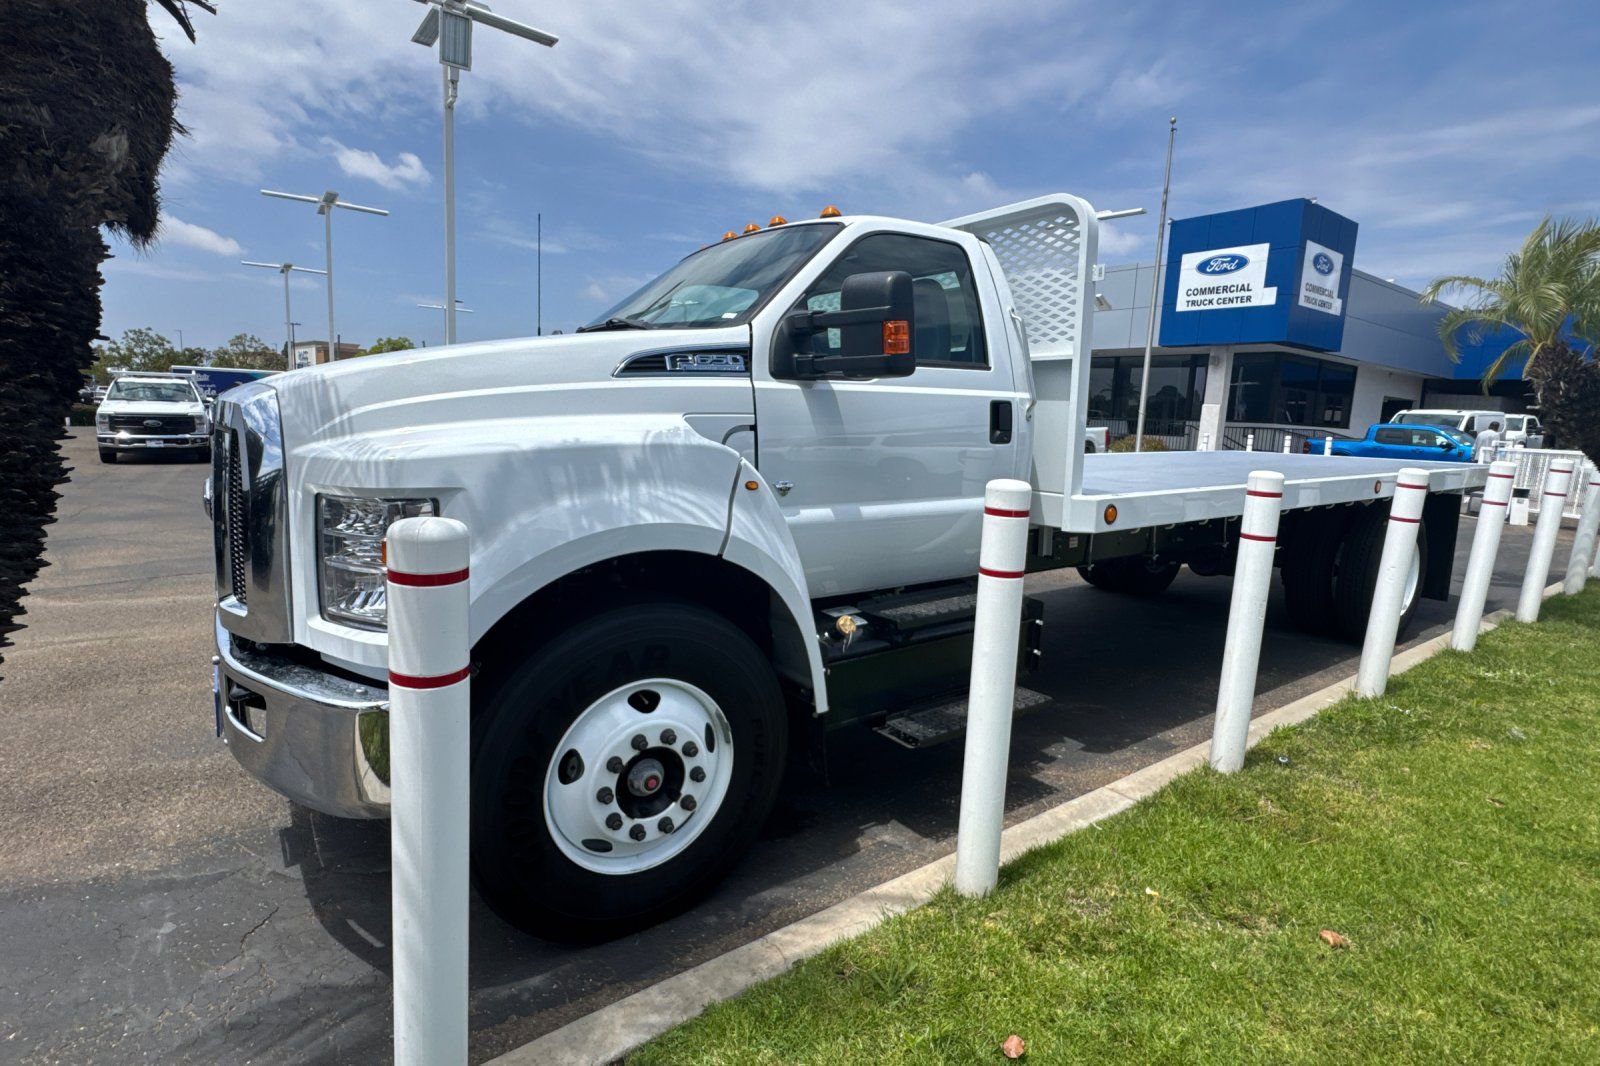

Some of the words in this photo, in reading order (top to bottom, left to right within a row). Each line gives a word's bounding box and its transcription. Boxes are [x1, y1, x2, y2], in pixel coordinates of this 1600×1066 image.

[1206, 257, 1239, 272] Ford
[1185, 283, 1253, 297] COMMERCIAL
[1305, 282, 1334, 299] COMMERCIAL
[1186, 298, 1214, 308] TRUCK
[1216, 295, 1252, 305] CENTER
